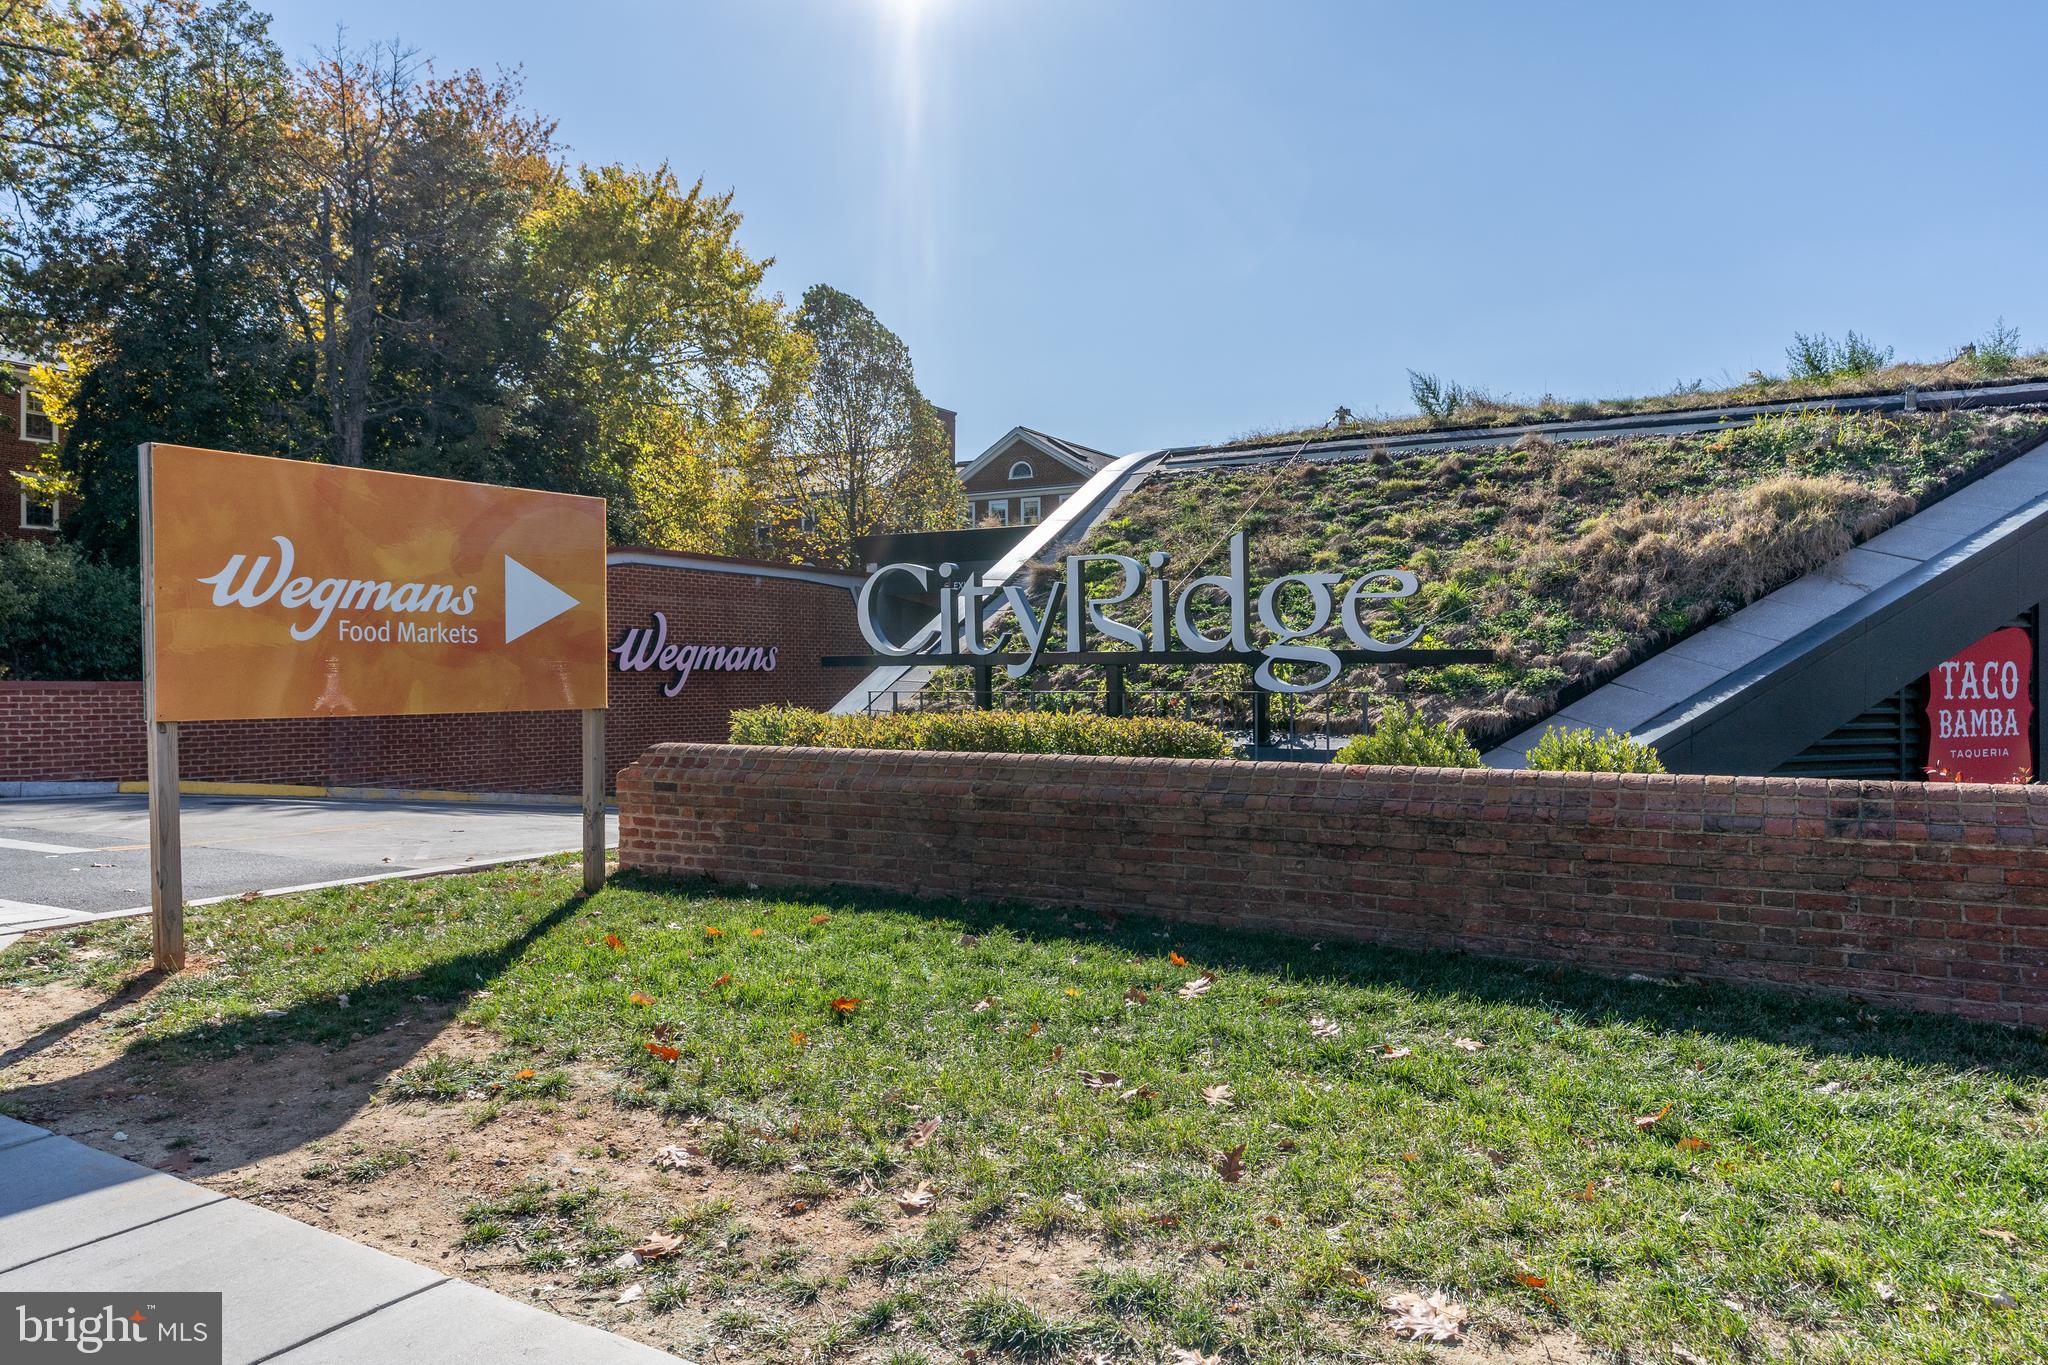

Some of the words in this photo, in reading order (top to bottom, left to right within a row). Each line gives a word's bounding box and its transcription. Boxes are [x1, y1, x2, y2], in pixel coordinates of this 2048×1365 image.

[196, 535, 478, 641] Wegmans
[338, 620, 391, 642] Food
[397, 621, 479, 644] Markets
[609, 611, 778, 698] Wegmans
[1937, 660, 2020, 701] TACO
[1938, 707, 2020, 739] BAMBA
[1950, 747, 2009, 759] TAQUERIA
